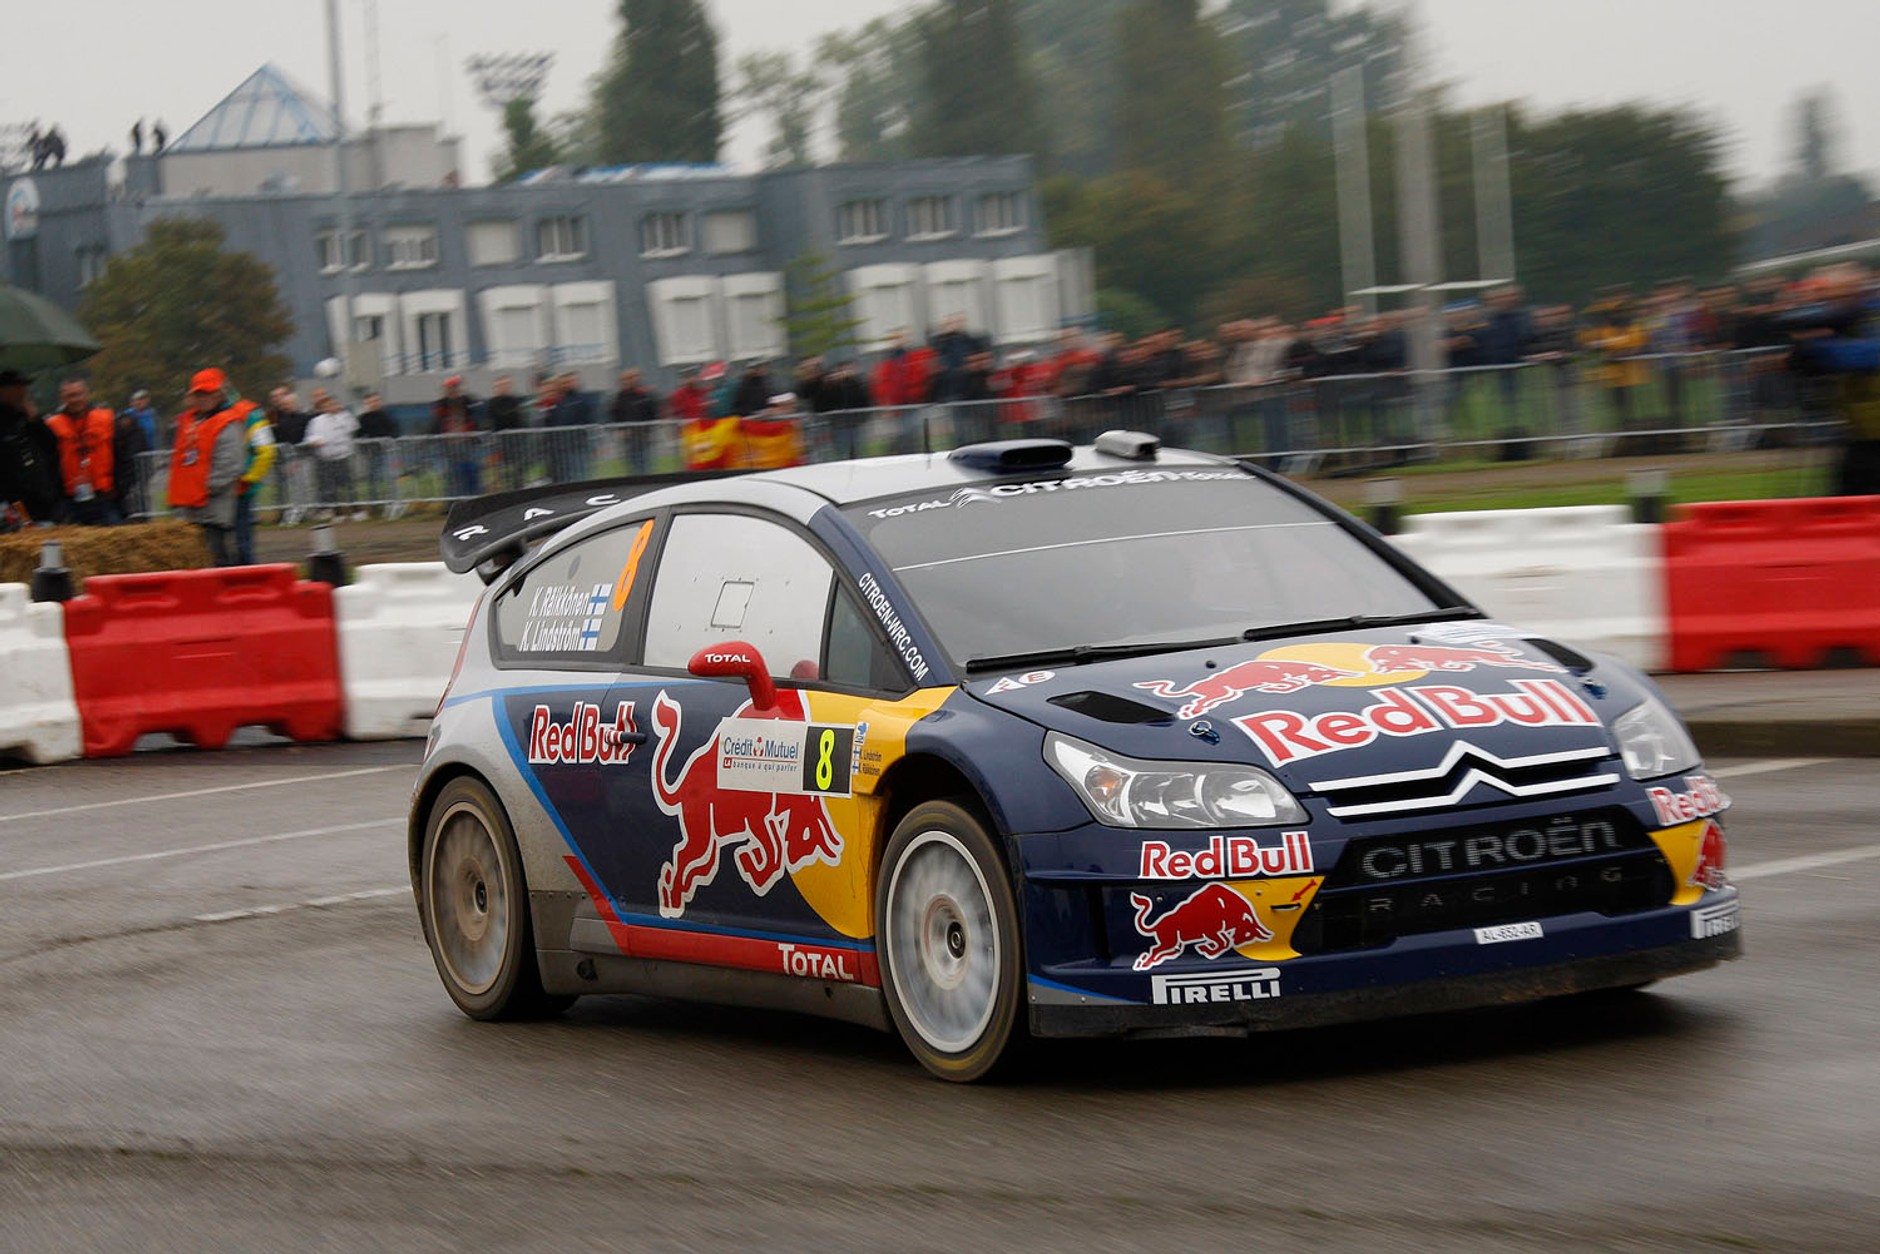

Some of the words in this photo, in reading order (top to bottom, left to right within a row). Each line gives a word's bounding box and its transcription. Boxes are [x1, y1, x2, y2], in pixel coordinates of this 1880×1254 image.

[868, 501, 953, 519] TOTAL
[613, 519, 655, 611] 8
[528, 586, 543, 617] K.
[519, 621, 533, 652] K.
[859, 573, 929, 682] CITROEN-WRC.COM
[705, 653, 751, 662] TOTAL
[724, 737, 753, 756] Crédit
[765, 740, 799, 758] Mutuel
[816, 729, 835, 790] 8
[733, 760, 755, 770] banque
[1369, 867, 1622, 911] RACING
[778, 943, 854, 980] TOTAL
[1151, 967, 1281, 1004] PIRELLI
